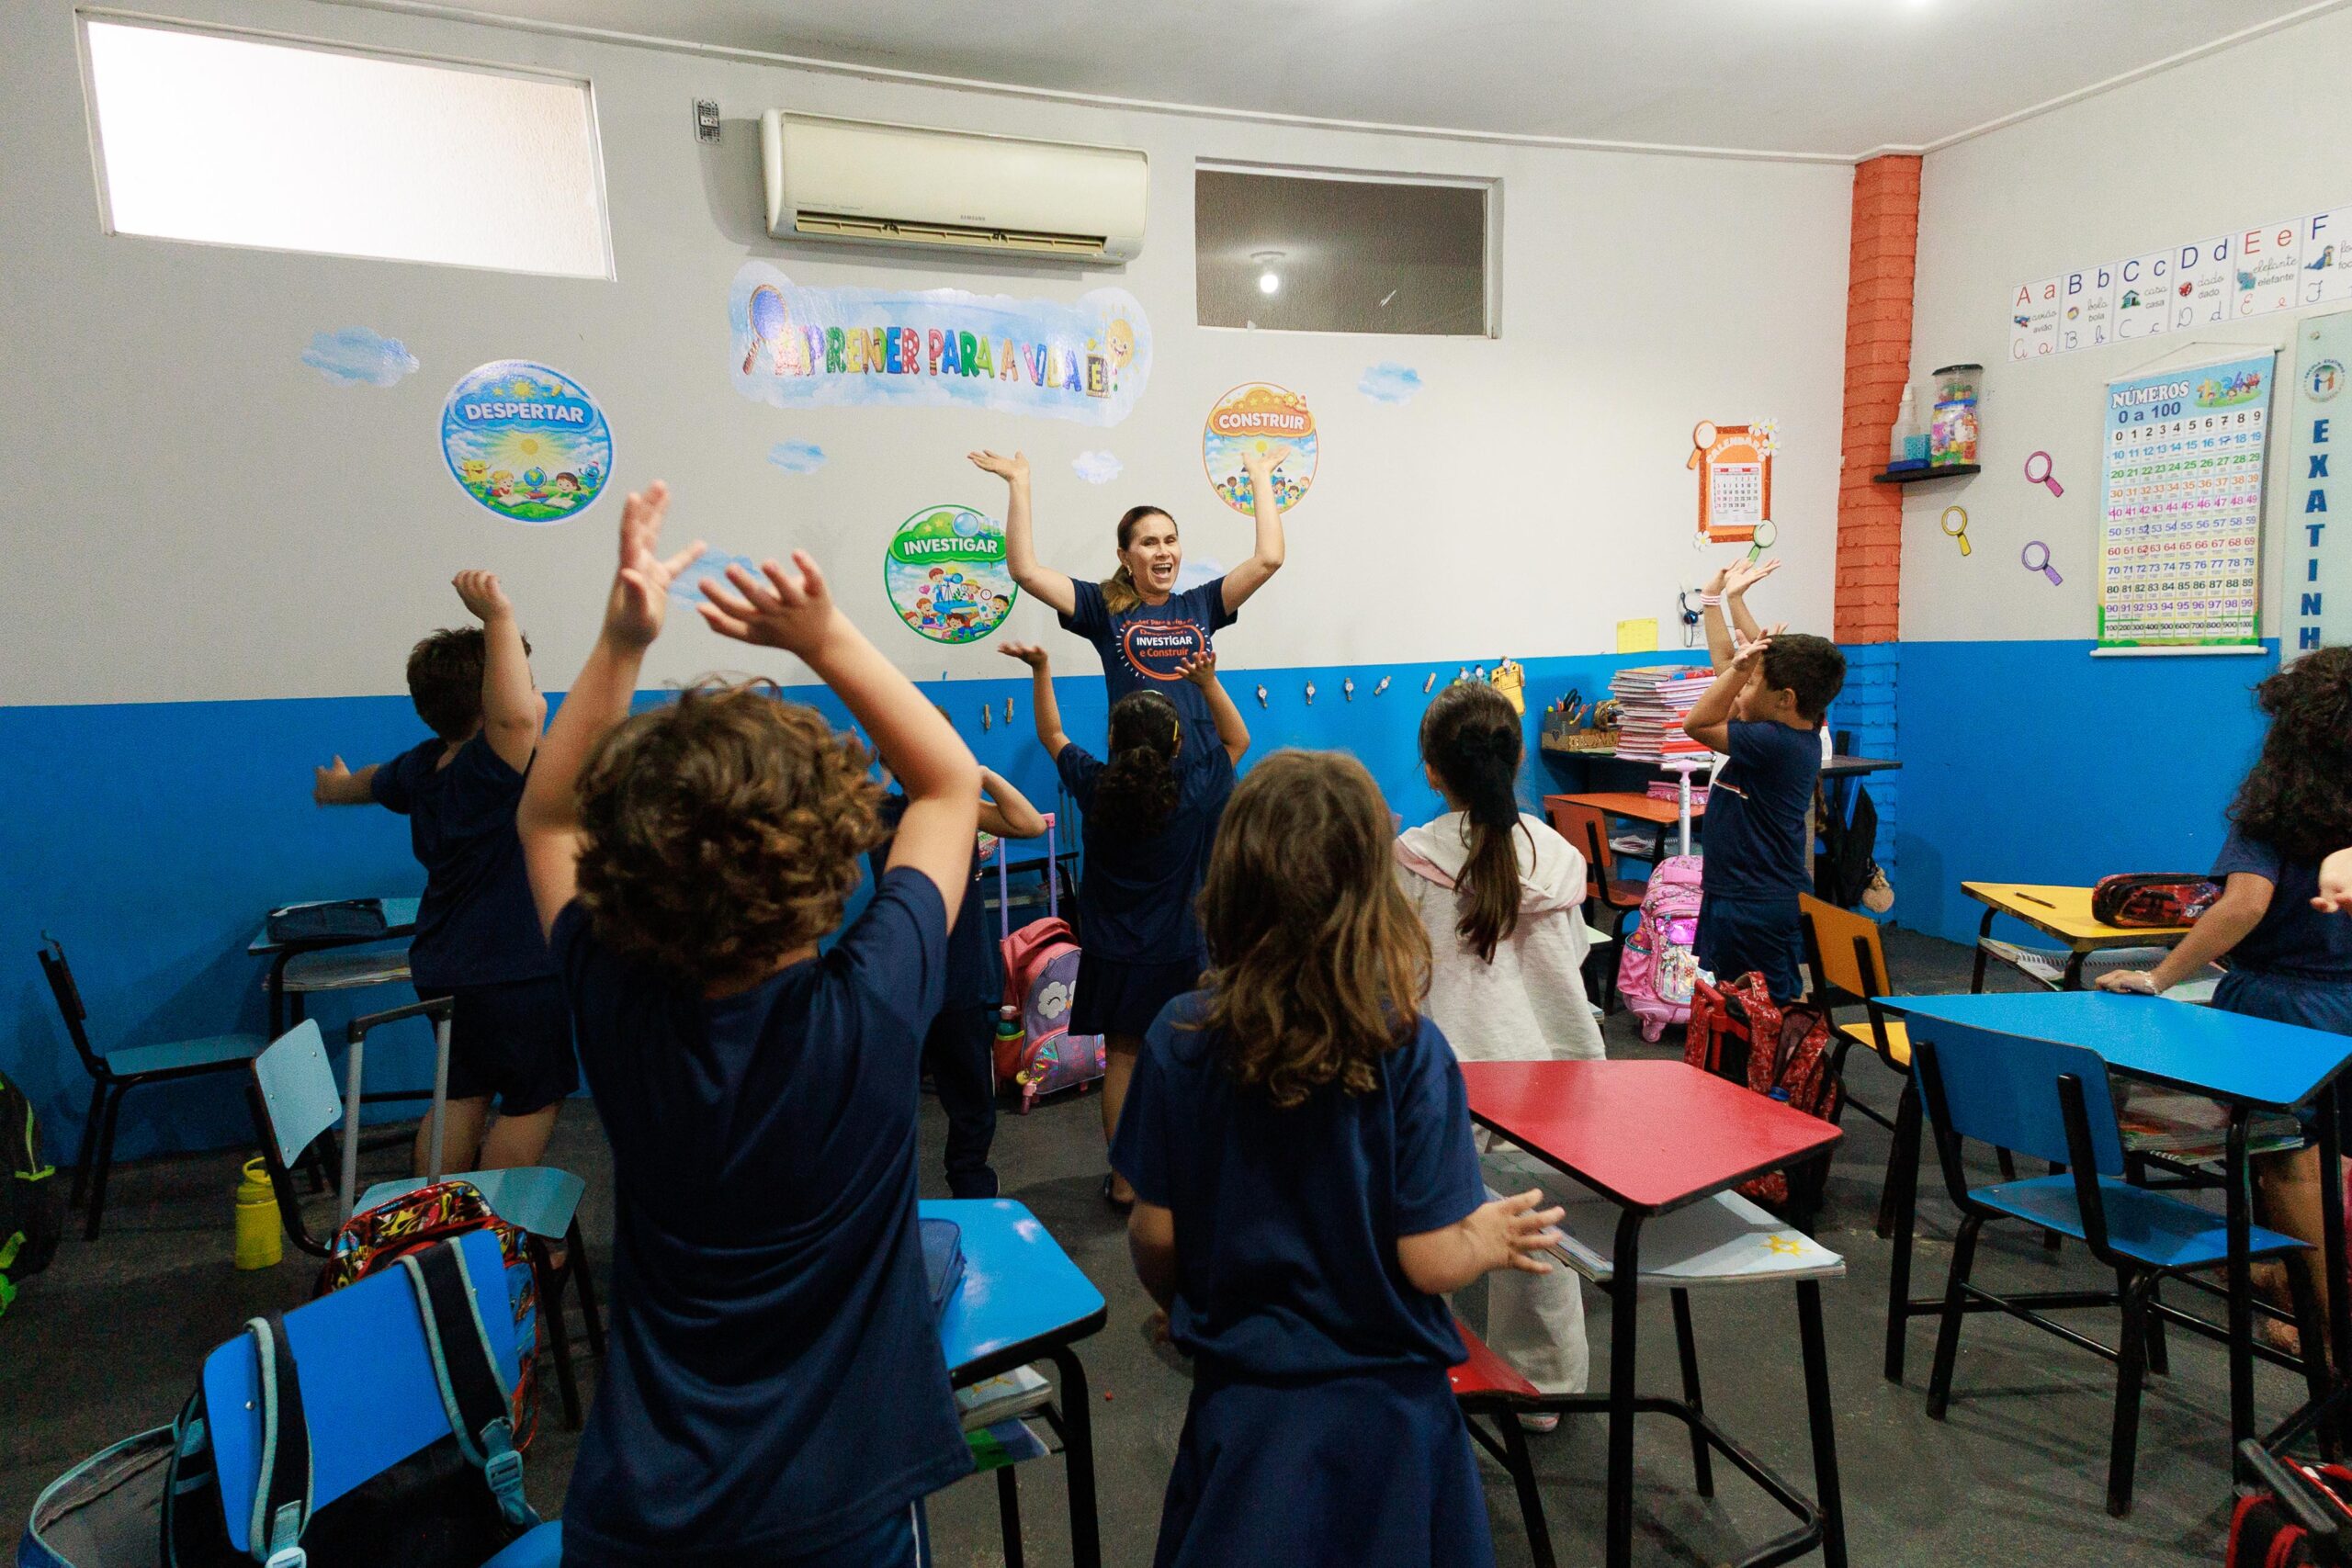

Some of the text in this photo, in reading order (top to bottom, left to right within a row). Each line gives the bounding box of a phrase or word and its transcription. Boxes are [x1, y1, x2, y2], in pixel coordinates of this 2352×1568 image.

[2312, 214, 2329, 241] F
[2245, 229, 2292, 254] E e
[2181, 237, 2228, 269] D d
[2068, 268, 2109, 295] B b
[2123, 260, 2166, 282] C c
[2016, 284, 2055, 307] A a
[929, 328, 995, 378] PARA
[1000, 338, 1019, 382] A
[2111, 380, 2190, 409] NÚMEROS
[464, 401, 584, 423] DESPERTAR
[1218, 412, 1304, 430] CONSTRUIR
[2118, 401, 2181, 423] 0 a 100
[2116, 432, 2122, 440] 0
[2132, 429, 2136, 437] 1
[2146, 427, 2152, 436] 2
[2160, 424, 2165, 434] 3
[2173, 423, 2179, 431] 4
[2188, 420, 2196, 429] 5
[2205, 418, 2212, 427] 6
[2237, 413, 2245, 423] 8
[2254, 411, 2260, 420] 9
[2112, 450, 2124, 459] 10
[2129, 448, 2139, 457] 11
[2143, 446, 2154, 455] 12
[2156, 444, 2166, 453] 13
[2185, 440, 2197, 449] 15
[2202, 438, 2213, 447] 16
[2233, 434, 2246, 443] 18
[2250, 431, 2262, 440] 19
[2111, 469, 2124, 479] 20
[2127, 468, 2138, 477] 21
[2141, 466, 2152, 475] 22
[2154, 464, 2165, 473] 23
[2168, 462, 2180, 471] 24
[2183, 460, 2196, 469] 25
[2199, 458, 2213, 468] 26
[2216, 457, 2229, 466] 27
[2233, 455, 2245, 464] 28
[2248, 453, 2261, 461] 29
[2110, 472, 2260, 497] 30 31 32 33 34 35 36 37 38 39
[2125, 505, 2135, 515] 41
[2139, 503, 2149, 514] 42
[2152, 504, 2163, 513] 43
[2165, 502, 2177, 512] 44
[2181, 501, 2193, 511] 45
[2214, 495, 2226, 506] 47
[2230, 496, 2243, 505] 48
[2125, 526, 2134, 535] 51
[2151, 524, 2162, 532] 53
[2165, 521, 2177, 531] 54
[2180, 521, 2192, 529] 55
[2196, 520, 2209, 528] 56
[2213, 518, 2226, 526] 57
[2230, 517, 2242, 525] 58
[2245, 515, 2257, 524] 59
[903, 537, 998, 556] INVESTIGAR
[2123, 546, 2133, 554] 61
[2150, 544, 2160, 552] 63
[2179, 541, 2191, 549] 65
[2195, 540, 2208, 548] 66
[2211, 539, 2224, 547] 67
[2228, 537, 2241, 546] 68
[2244, 536, 2255, 545] 69
[2108, 566, 2120, 574] 70
[2123, 565, 2132, 573] 71
[2136, 564, 2146, 572] 72
[2148, 563, 2160, 571] 73
[2178, 561, 2190, 570] 75
[2194, 560, 2206, 569] 76
[2211, 559, 2223, 568] 77
[2227, 558, 2240, 567] 78
[2107, 585, 2119, 593] 80
[2147, 583, 2158, 592] 83
[2177, 581, 2189, 590] 85
[2193, 581, 2205, 589] 86
[2209, 580, 2222, 588] 87
[2225, 579, 2238, 587] 88
[2242, 578, 2255, 586] 89
[2120, 604, 2132, 613] 91
[2133, 601, 2143, 611] 92
[2145, 600, 2157, 611] 93
[2208, 600, 2221, 608] 97
[2241, 599, 2254, 607] 99
[1136, 635, 1193, 647] INVESTIGAR
[1147, 647, 1189, 657] Construir
